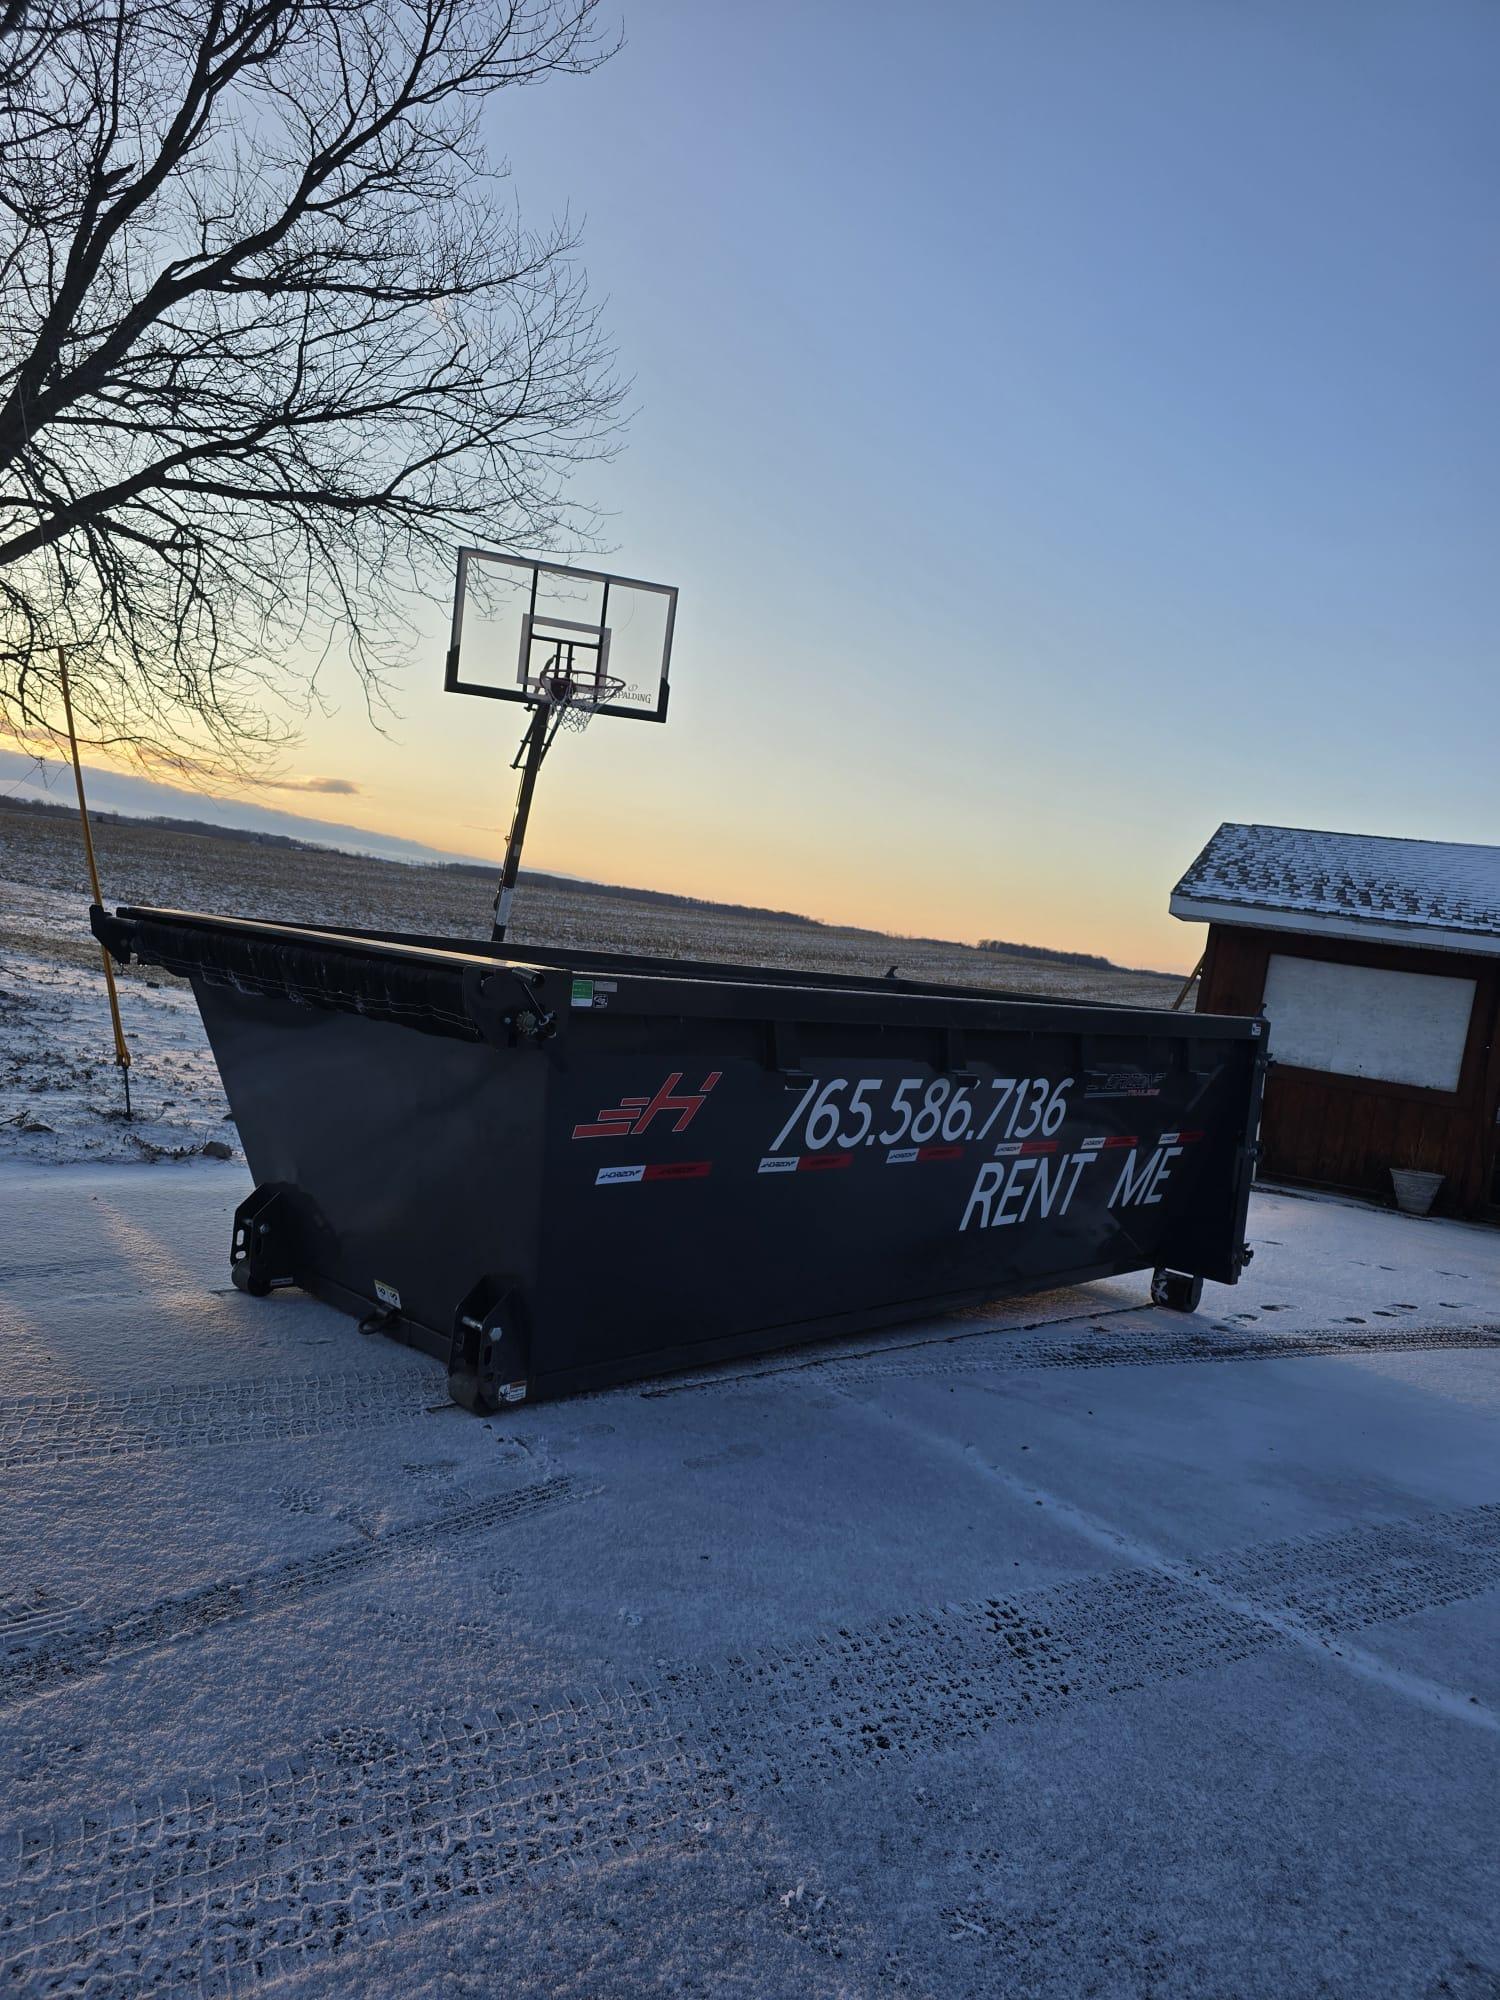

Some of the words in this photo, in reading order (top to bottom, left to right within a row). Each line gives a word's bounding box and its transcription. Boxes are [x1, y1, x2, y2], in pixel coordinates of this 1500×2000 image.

[769, 1078, 1075, 1152] 765.586.7136
[958, 1152, 1098, 1231] RENT
[1107, 1146, 1184, 1209] ME
